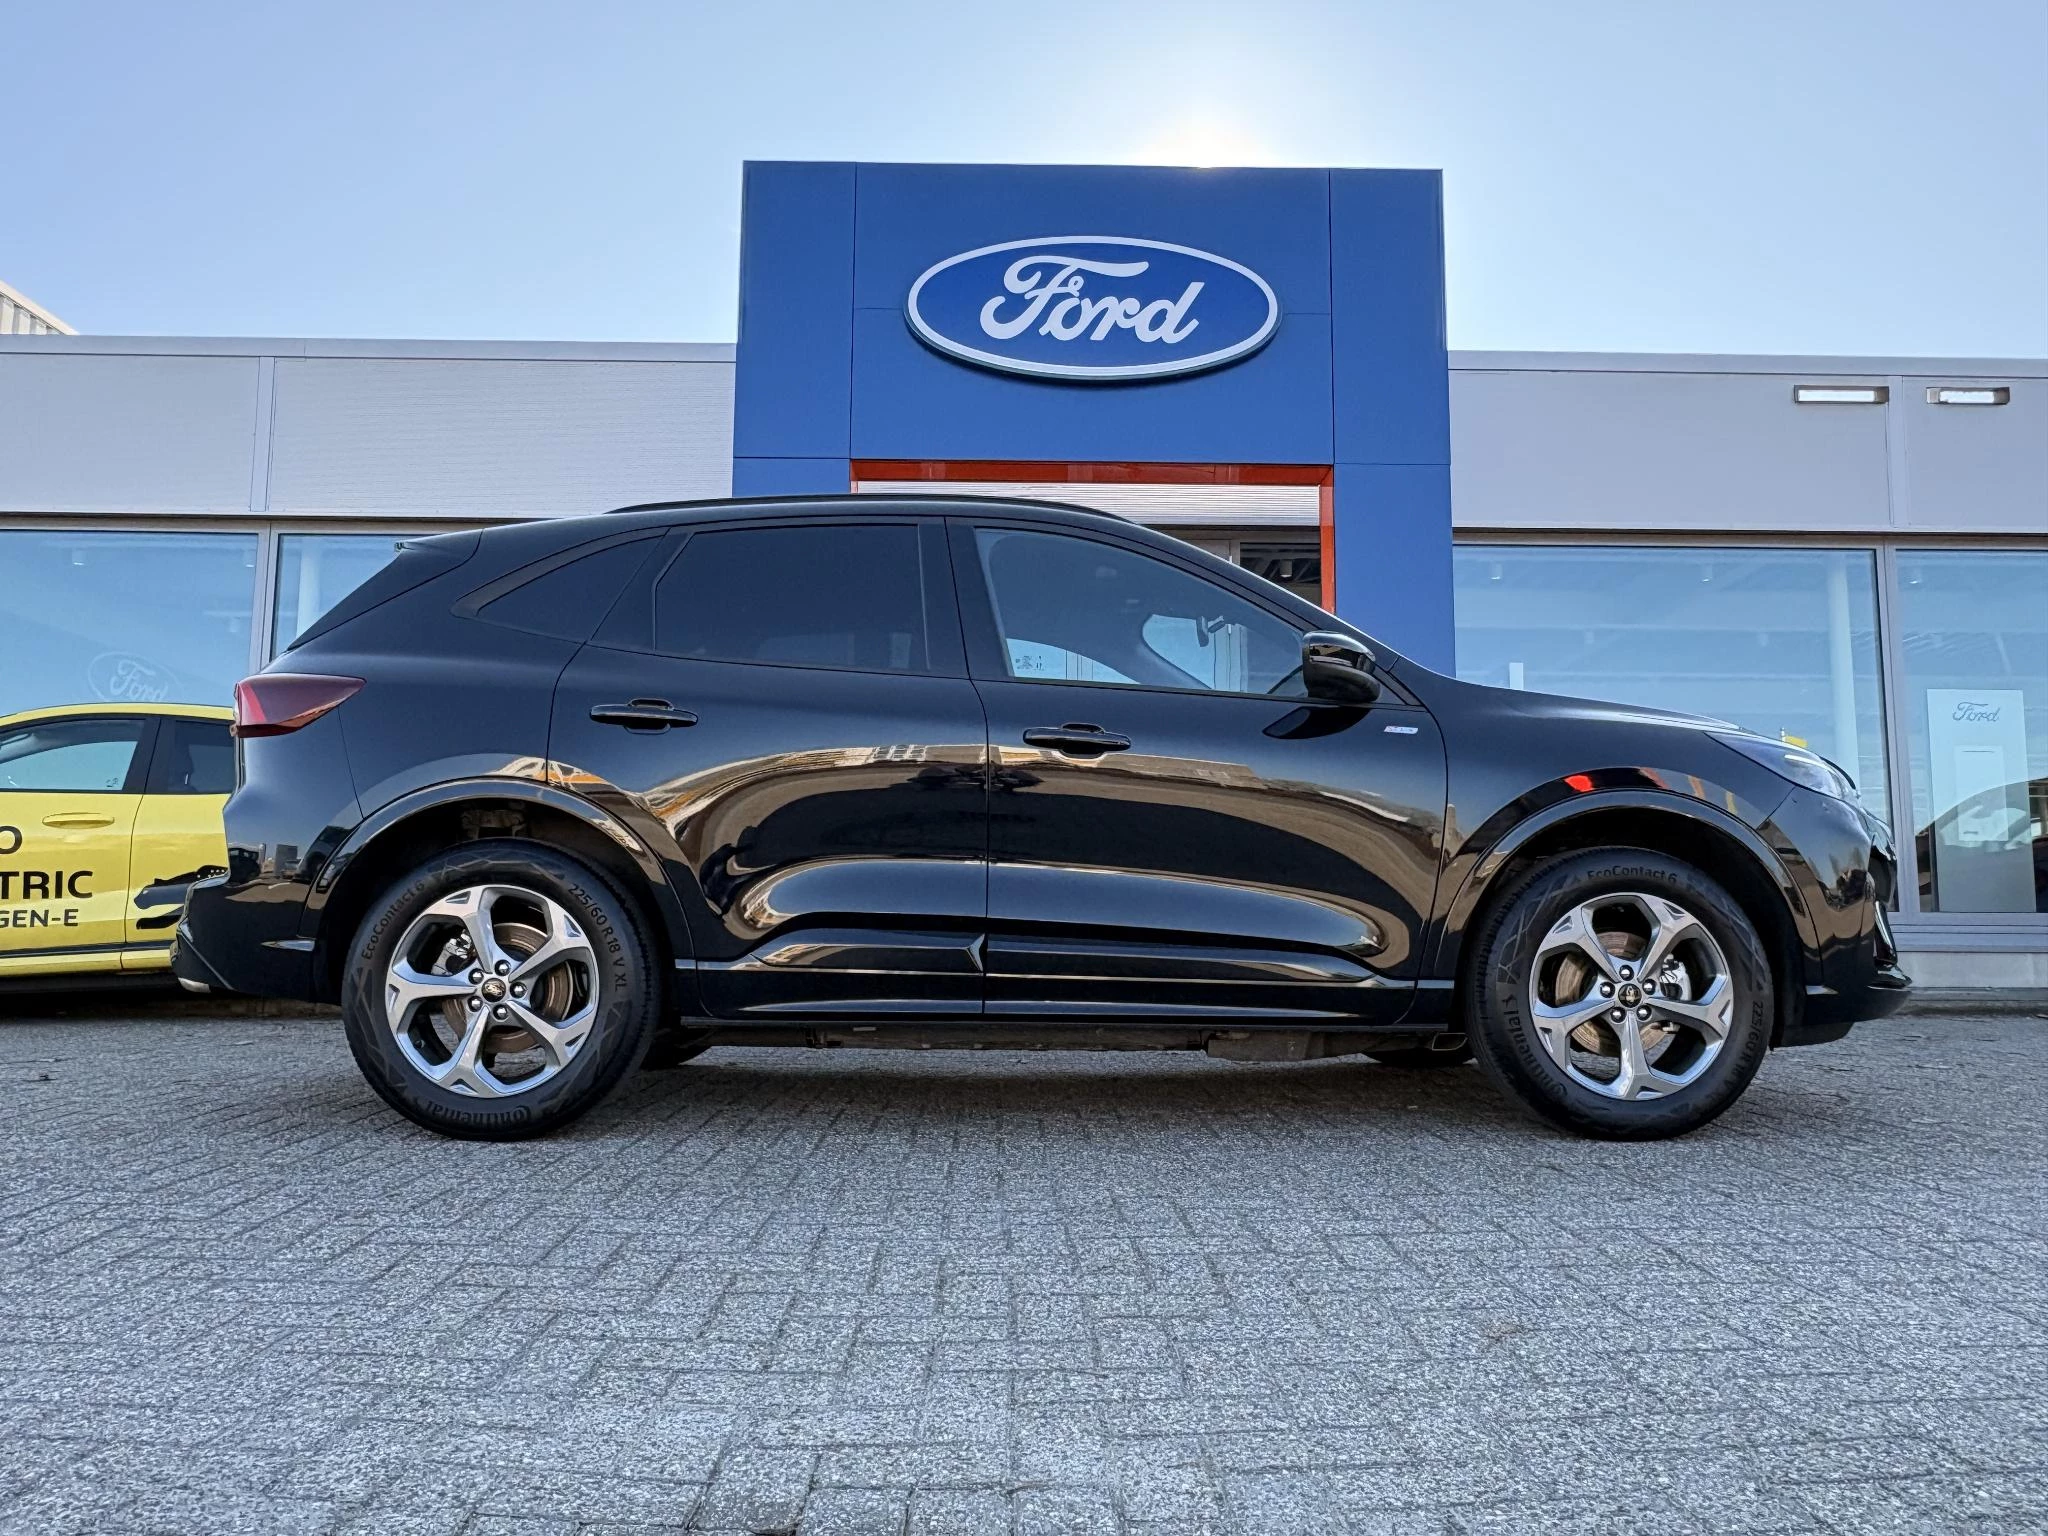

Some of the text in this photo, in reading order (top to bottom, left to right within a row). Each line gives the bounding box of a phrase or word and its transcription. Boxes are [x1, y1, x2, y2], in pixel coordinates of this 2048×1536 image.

[980, 255, 1205, 344] Ford
[109, 659, 169, 702] Ford
[1952, 701, 2001, 722] Ford
[0, 870, 93, 900] TRIC
[1587, 865, 1678, 885] EcoContact 6
[567, 883, 608, 926] 225/60
[361, 888, 416, 960] EcoContact
[612, 957, 625, 967] V
[614, 972, 628, 992] XL
[424, 1100, 533, 1125] Continental
